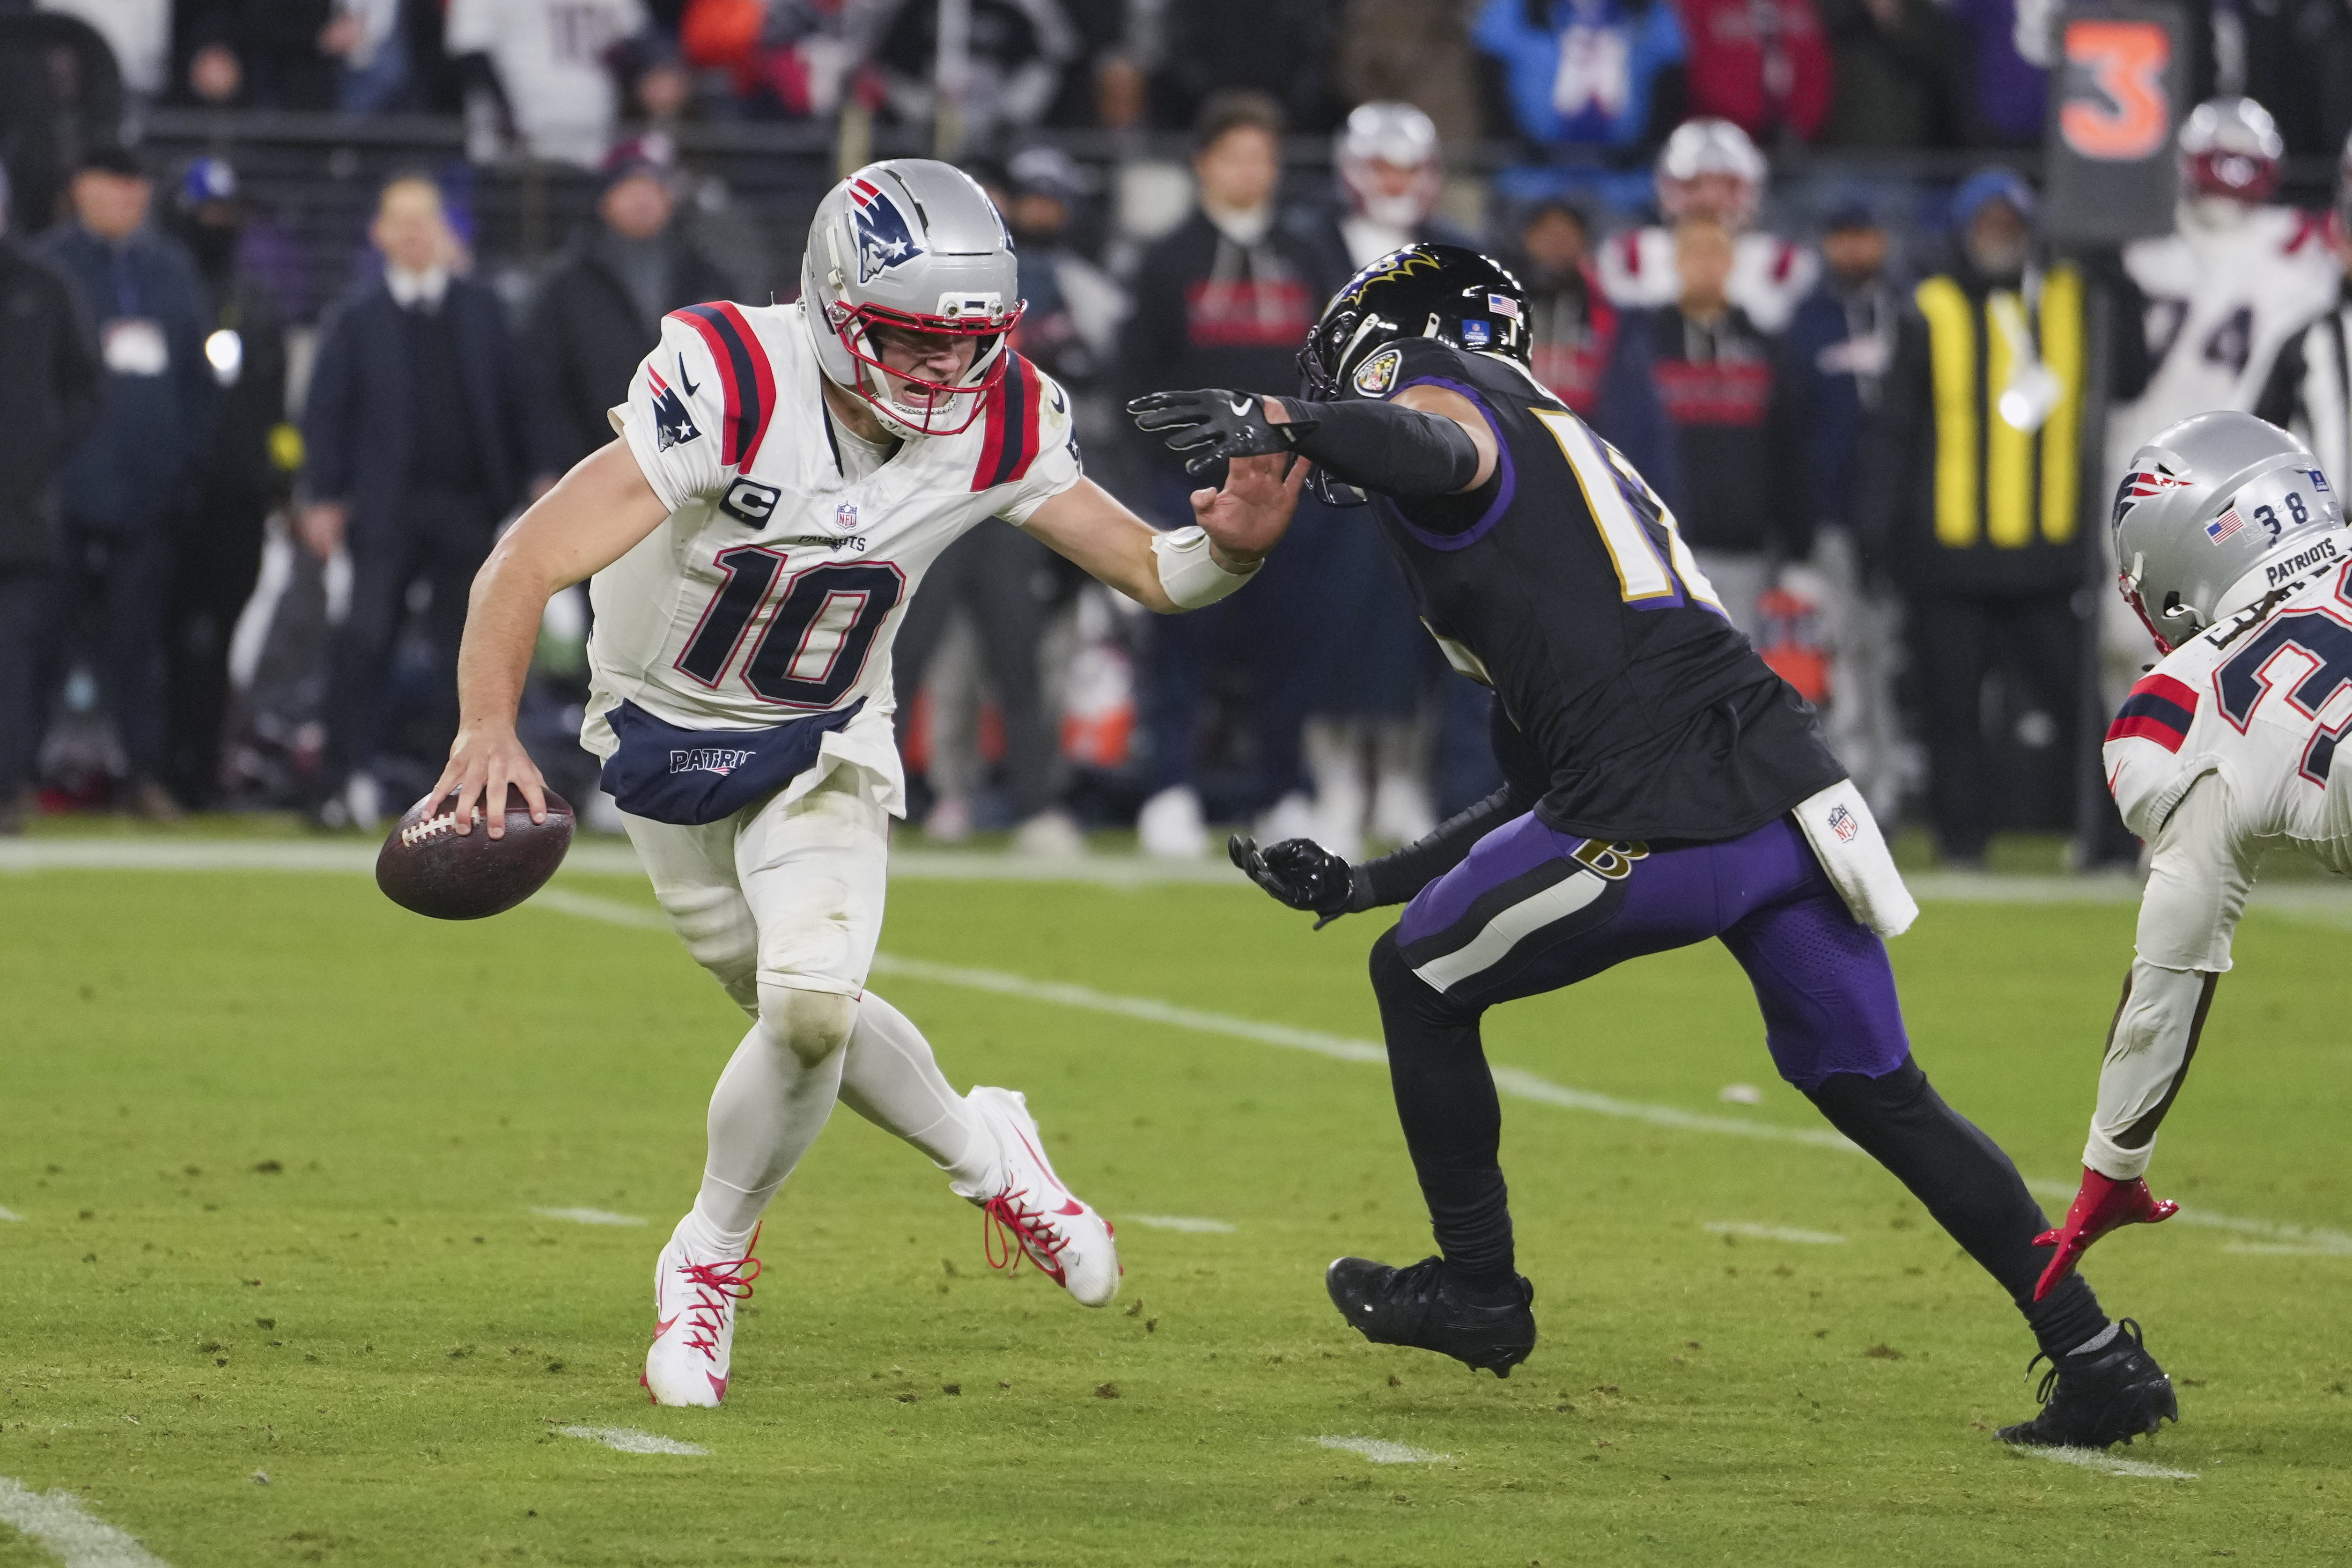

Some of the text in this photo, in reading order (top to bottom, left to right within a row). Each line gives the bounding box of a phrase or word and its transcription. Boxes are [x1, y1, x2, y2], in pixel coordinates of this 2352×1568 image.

[2061, 20, 2171, 160] 3
[728, 483, 775, 518] C
[839, 514, 855, 526] NFL
[2254, 492, 2308, 535] 38
[2266, 537, 2337, 588] PATRIOTS
[672, 544, 907, 709] 10
[2212, 557, 2352, 791] 3
[1835, 817, 1855, 841] NFL
[1570, 839, 1650, 881] B
